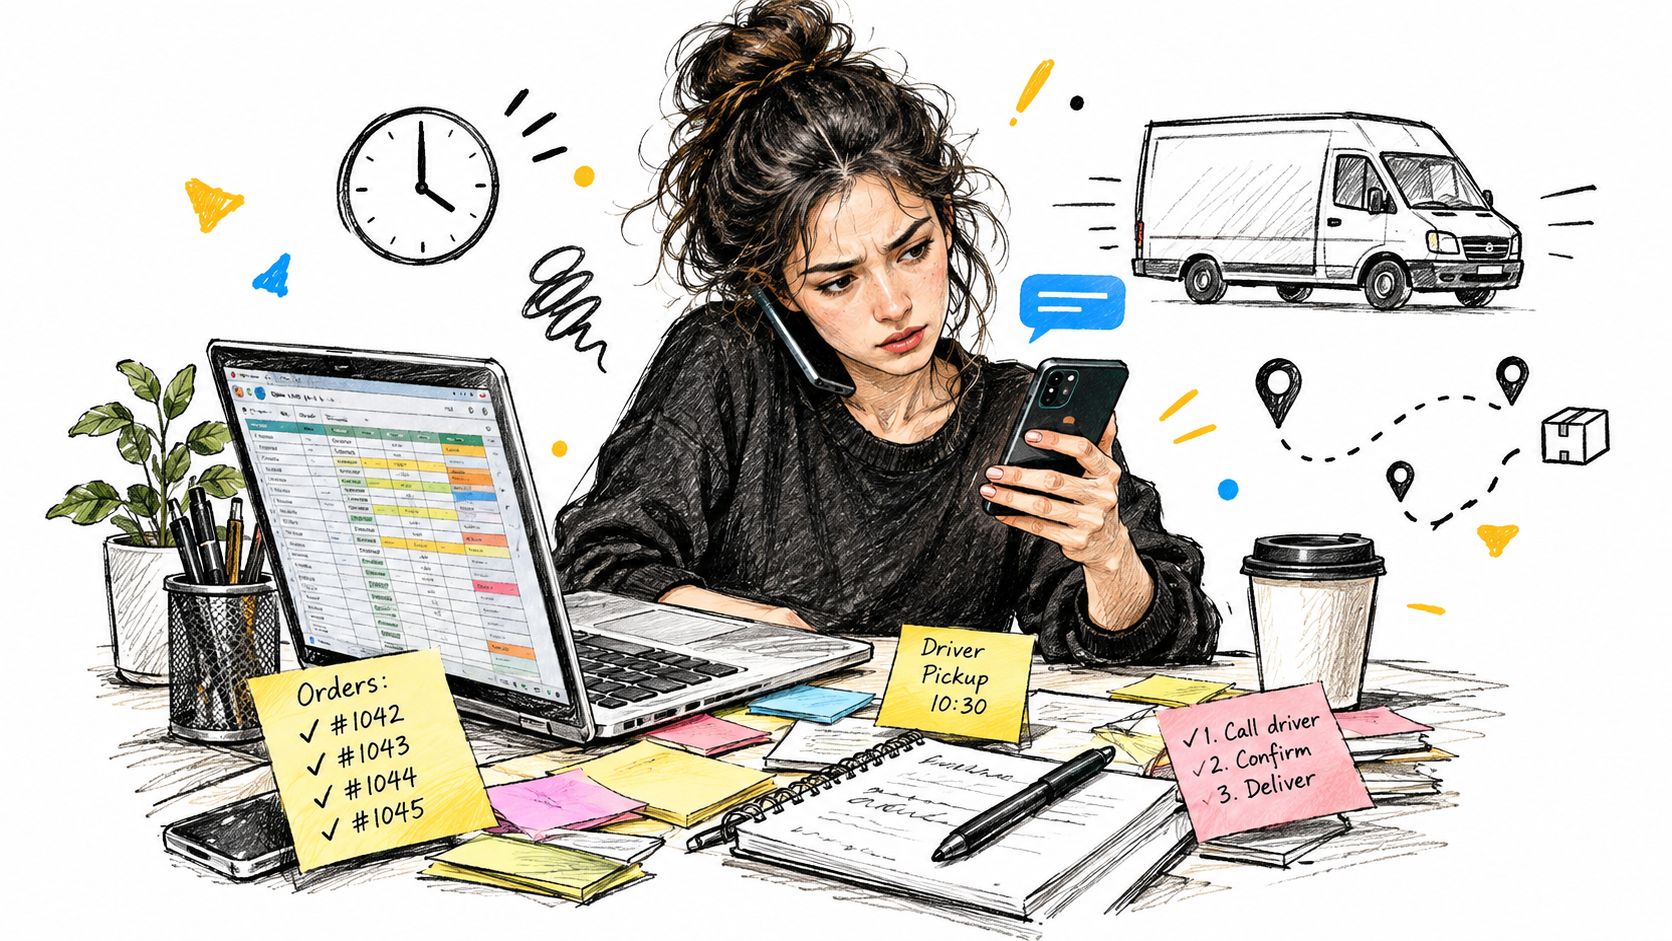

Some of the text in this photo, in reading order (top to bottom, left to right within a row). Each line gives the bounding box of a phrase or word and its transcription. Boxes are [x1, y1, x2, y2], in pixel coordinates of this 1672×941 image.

[920, 637, 986, 659] Driver
[297, 674, 390, 707] Orders:
[922, 664, 989, 695] Pickup
[330, 704, 405, 736] #1042
[930, 694, 987, 715] 10:30
[1204, 713, 1320, 745] 1. Call driver
[337, 735, 410, 769] #1043
[1209, 742, 1312, 775] 2. Confirm
[343, 766, 417, 801] #1044
[1217, 773, 1316, 804] 3. Deliver
[351, 797, 424, 834] #1045
